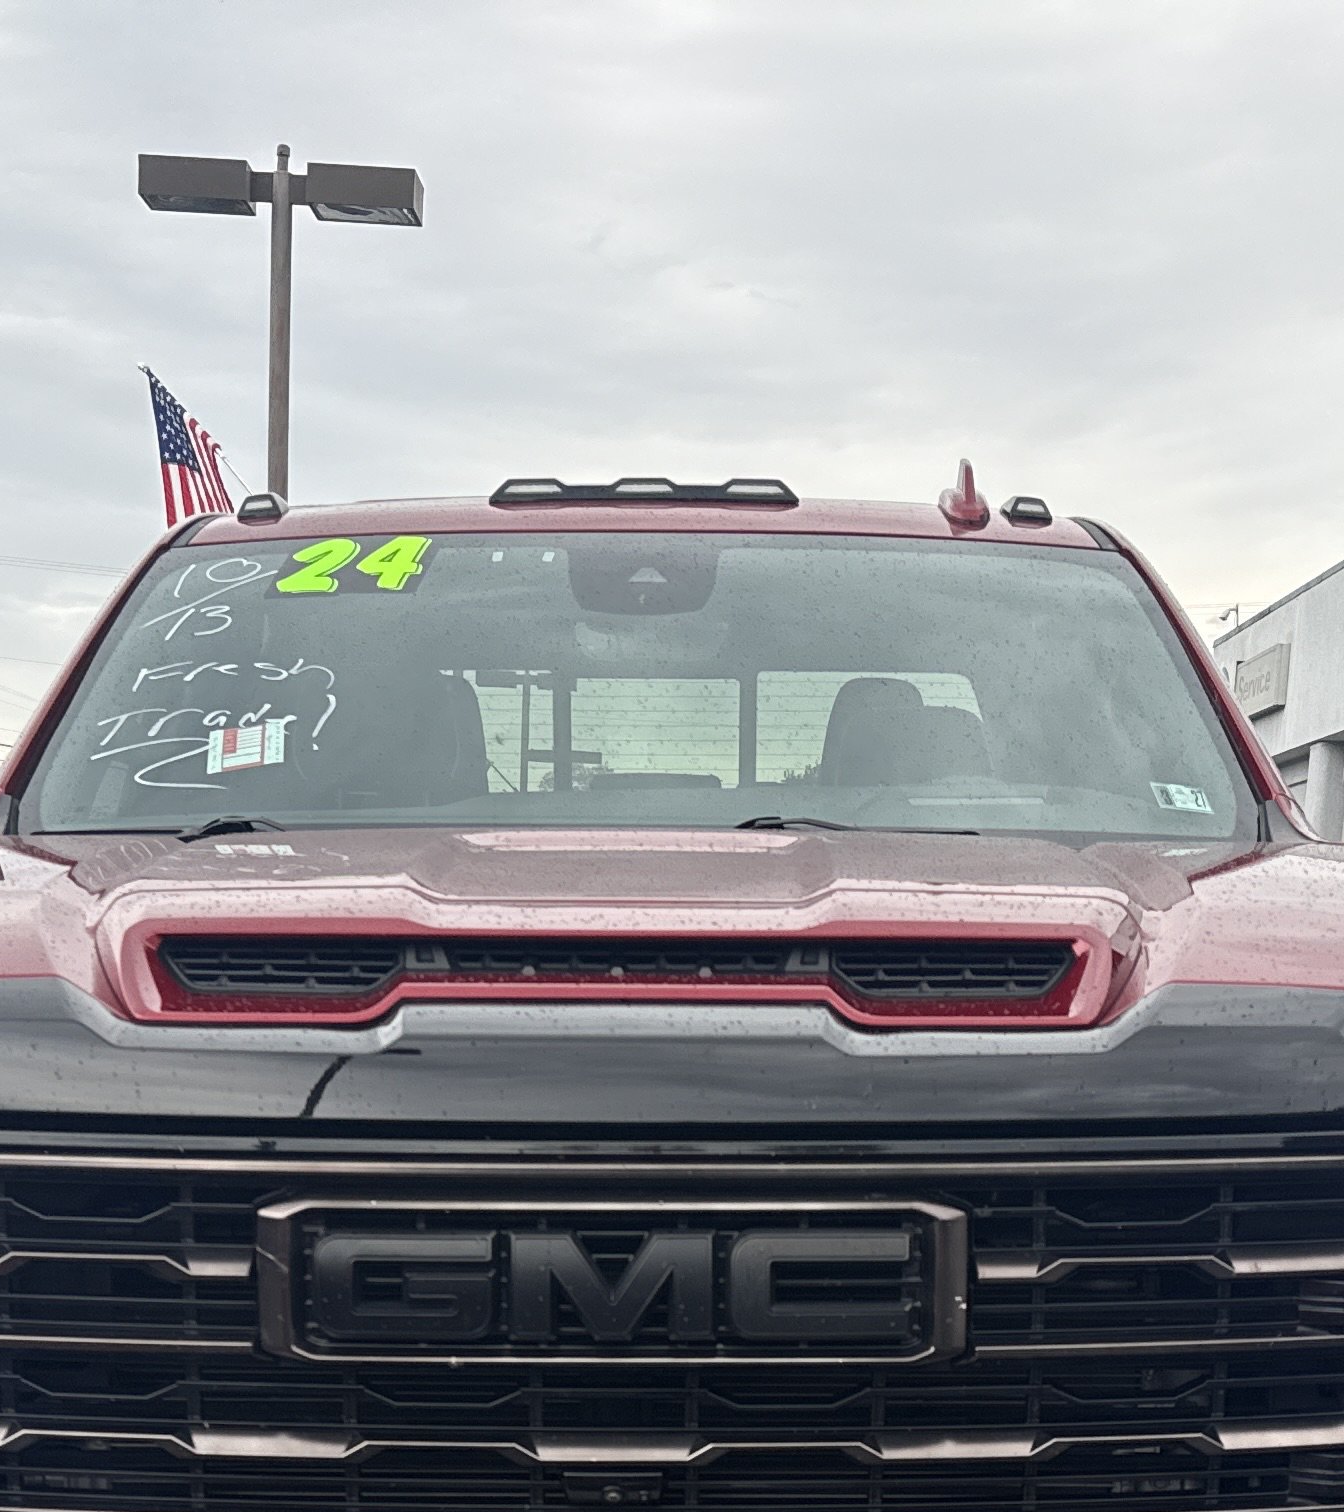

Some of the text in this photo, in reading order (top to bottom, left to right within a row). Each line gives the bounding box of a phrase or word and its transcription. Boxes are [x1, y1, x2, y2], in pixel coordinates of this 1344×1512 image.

[276, 536, 432, 593] 24
[132, 658, 335, 693] Fresh
[1238, 670, 1272, 701] Service
[1190, 789, 1207, 810] 27
[313, 1229, 912, 1340] GMC
